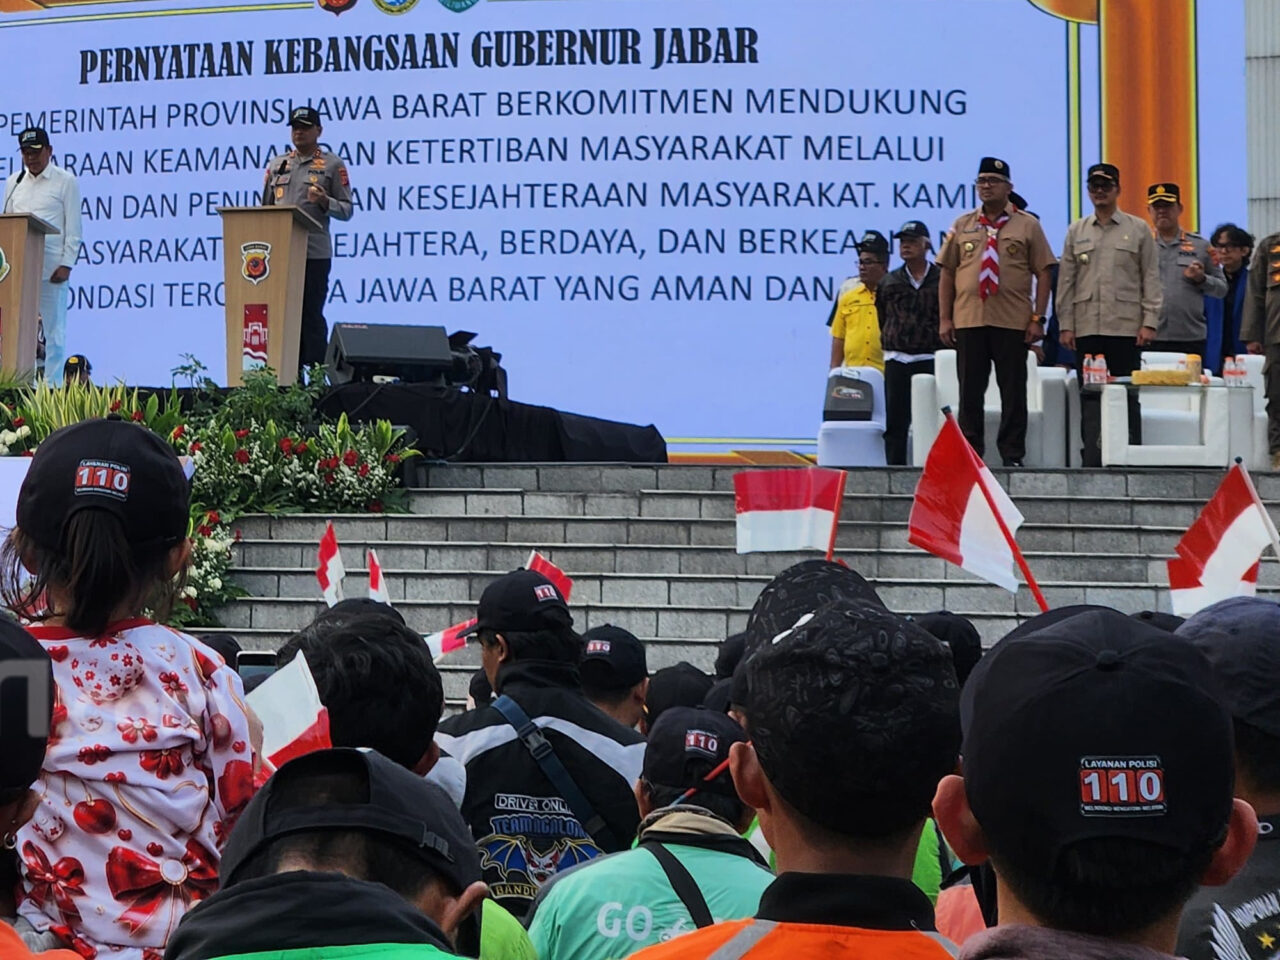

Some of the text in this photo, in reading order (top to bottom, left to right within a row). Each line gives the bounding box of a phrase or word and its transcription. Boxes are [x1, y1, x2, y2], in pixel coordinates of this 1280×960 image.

[79, 27, 759, 84] PERNYATAAN KEBANGSAAN GUBERNUR JABAR
[393, 93, 486, 119] BARAT
[498, 89, 732, 117] BERKOMITMEN
[746, 88, 967, 116] MENDUKUNG
[387, 137, 567, 165] KETERTIBAN
[582, 135, 792, 162] MASYARAKAT
[804, 136, 944, 162] MELALUI
[123, 193, 178, 220] DAN
[399, 183, 648, 211] KESEJAHTERAAN
[661, 182, 880, 208] MASYARAKAT.
[893, 183, 976, 209] KAMI
[75, 237, 223, 266] ASYARAKAT
[334, 231, 487, 261] EJAHTERA,
[501, 229, 645, 259] BERDAYA,
[659, 228, 725, 254] DAN
[67, 283, 154, 310] ONDASI
[357, 278, 437, 304] JAWA
[449, 276, 546, 302] BARAT
[555, 275, 638, 302] YANG
[651, 275, 751, 301] AMAN
[766, 275, 834, 301] DAN
[79, 467, 128, 491] 110
[686, 733, 718, 751] 110
[1084, 760, 1157, 768] LAYANAN POLISI
[1084, 771, 1160, 801] 110
[597, 902, 653, 941] GO
